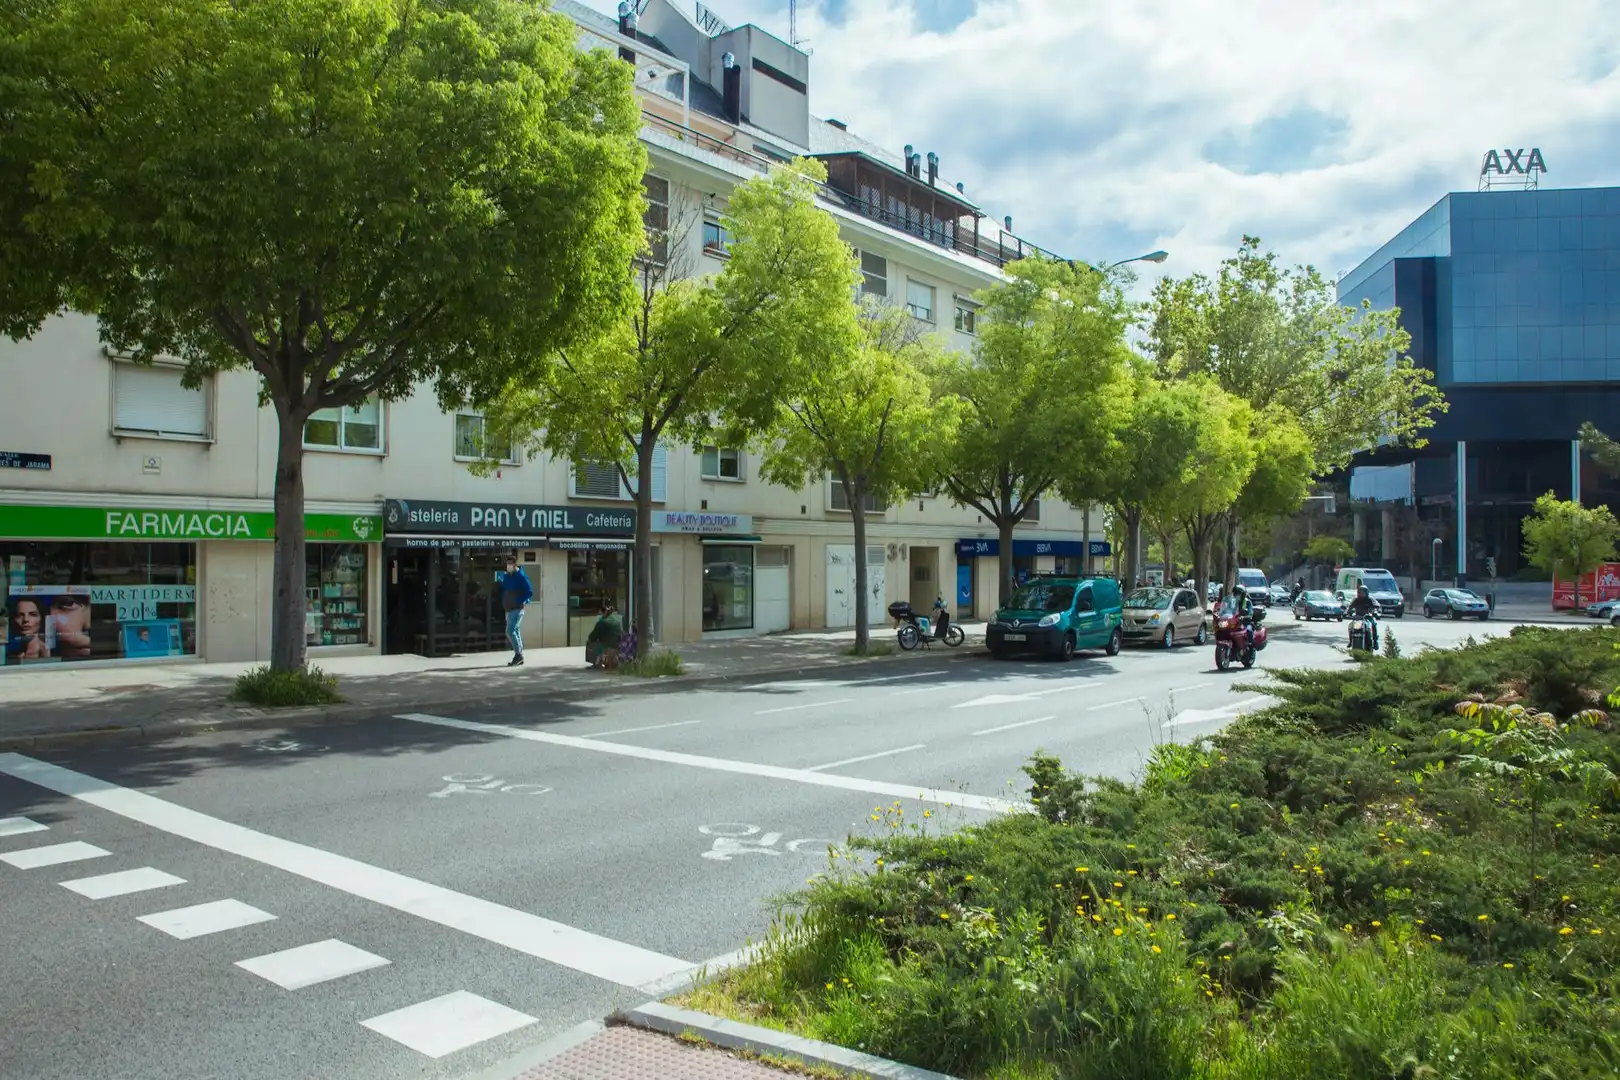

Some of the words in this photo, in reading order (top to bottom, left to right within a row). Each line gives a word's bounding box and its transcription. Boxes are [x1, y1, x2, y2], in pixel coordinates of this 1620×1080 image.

[1481, 148, 1547, 175] AXA
[26, 461, 50, 469] JARAMA
[106, 512, 251, 536] FARMACIA
[408, 508, 459, 523] stelería
[471, 507, 510, 527] PAN
[515, 508, 526, 528] Y
[532, 509, 574, 529] MIEL
[586, 513, 632, 527] Cafetería
[667, 514, 698, 525] BEAUTY
[701, 515, 738, 526] BOUTIQUE
[441, 540, 454, 548] pan
[1036, 543, 1052, 553] BBVA
[1091, 544, 1105, 553] BBVA
[887, 542, 907, 563] 31
[91, 588, 195, 601] MARTIDERM
